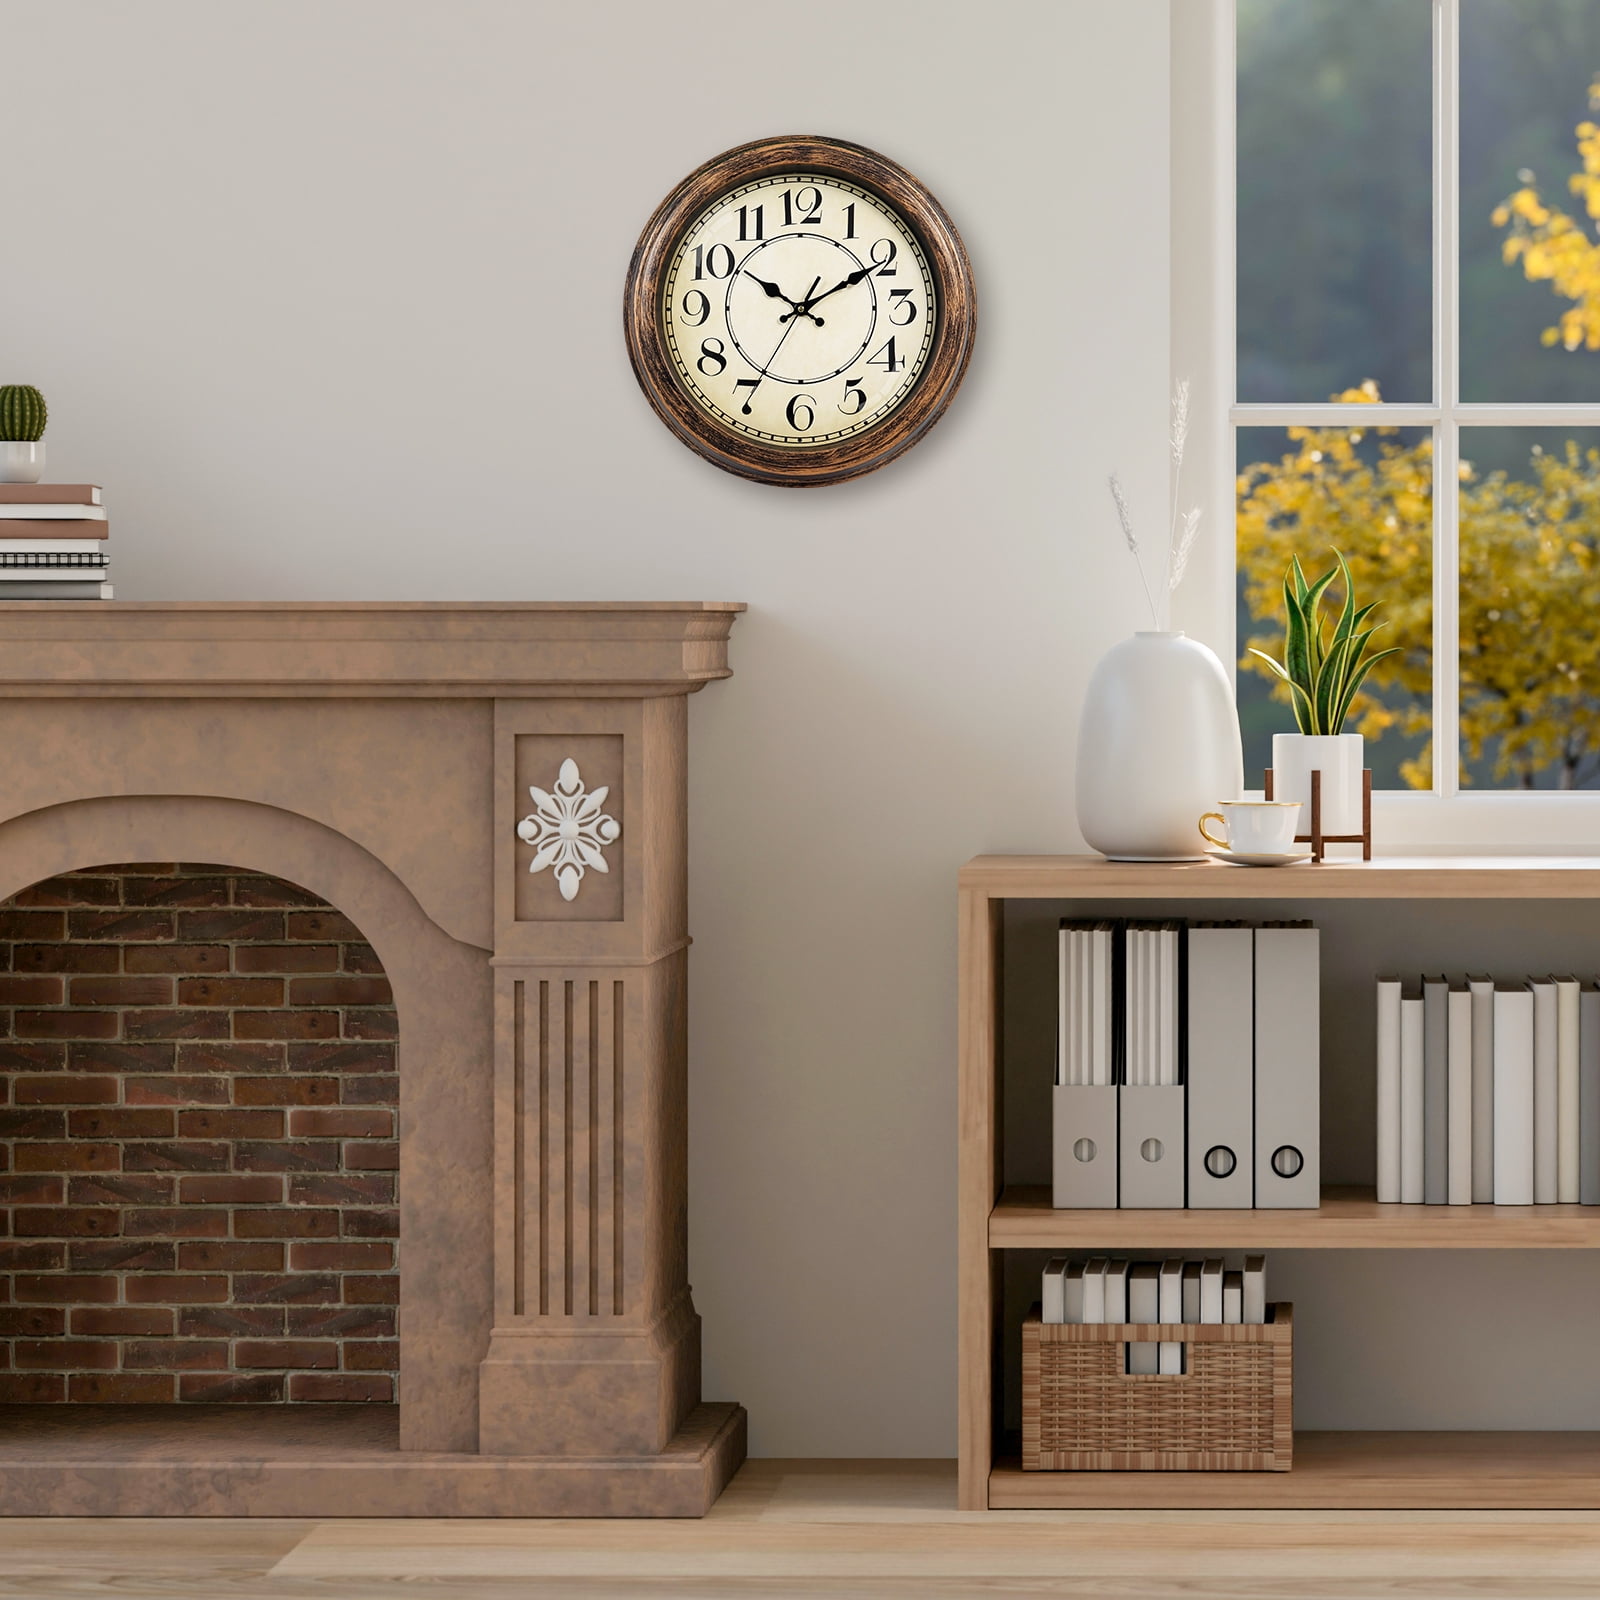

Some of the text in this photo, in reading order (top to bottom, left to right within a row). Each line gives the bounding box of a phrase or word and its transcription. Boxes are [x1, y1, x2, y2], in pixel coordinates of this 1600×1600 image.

[734, 204, 768, 242] 11
[778, 186, 823, 226] 12
[841, 202, 860, 240] 1
[690, 243, 736, 281] 10
[869, 238, 898, 277] 2
[680, 289, 711, 327] 9
[887, 288, 917, 326] 3
[696, 337, 727, 376] 8
[866, 335, 906, 373] 4
[732, 378, 762, 415] 7
[785, 393, 817, 431] 6
[837, 376, 867, 415] 5
